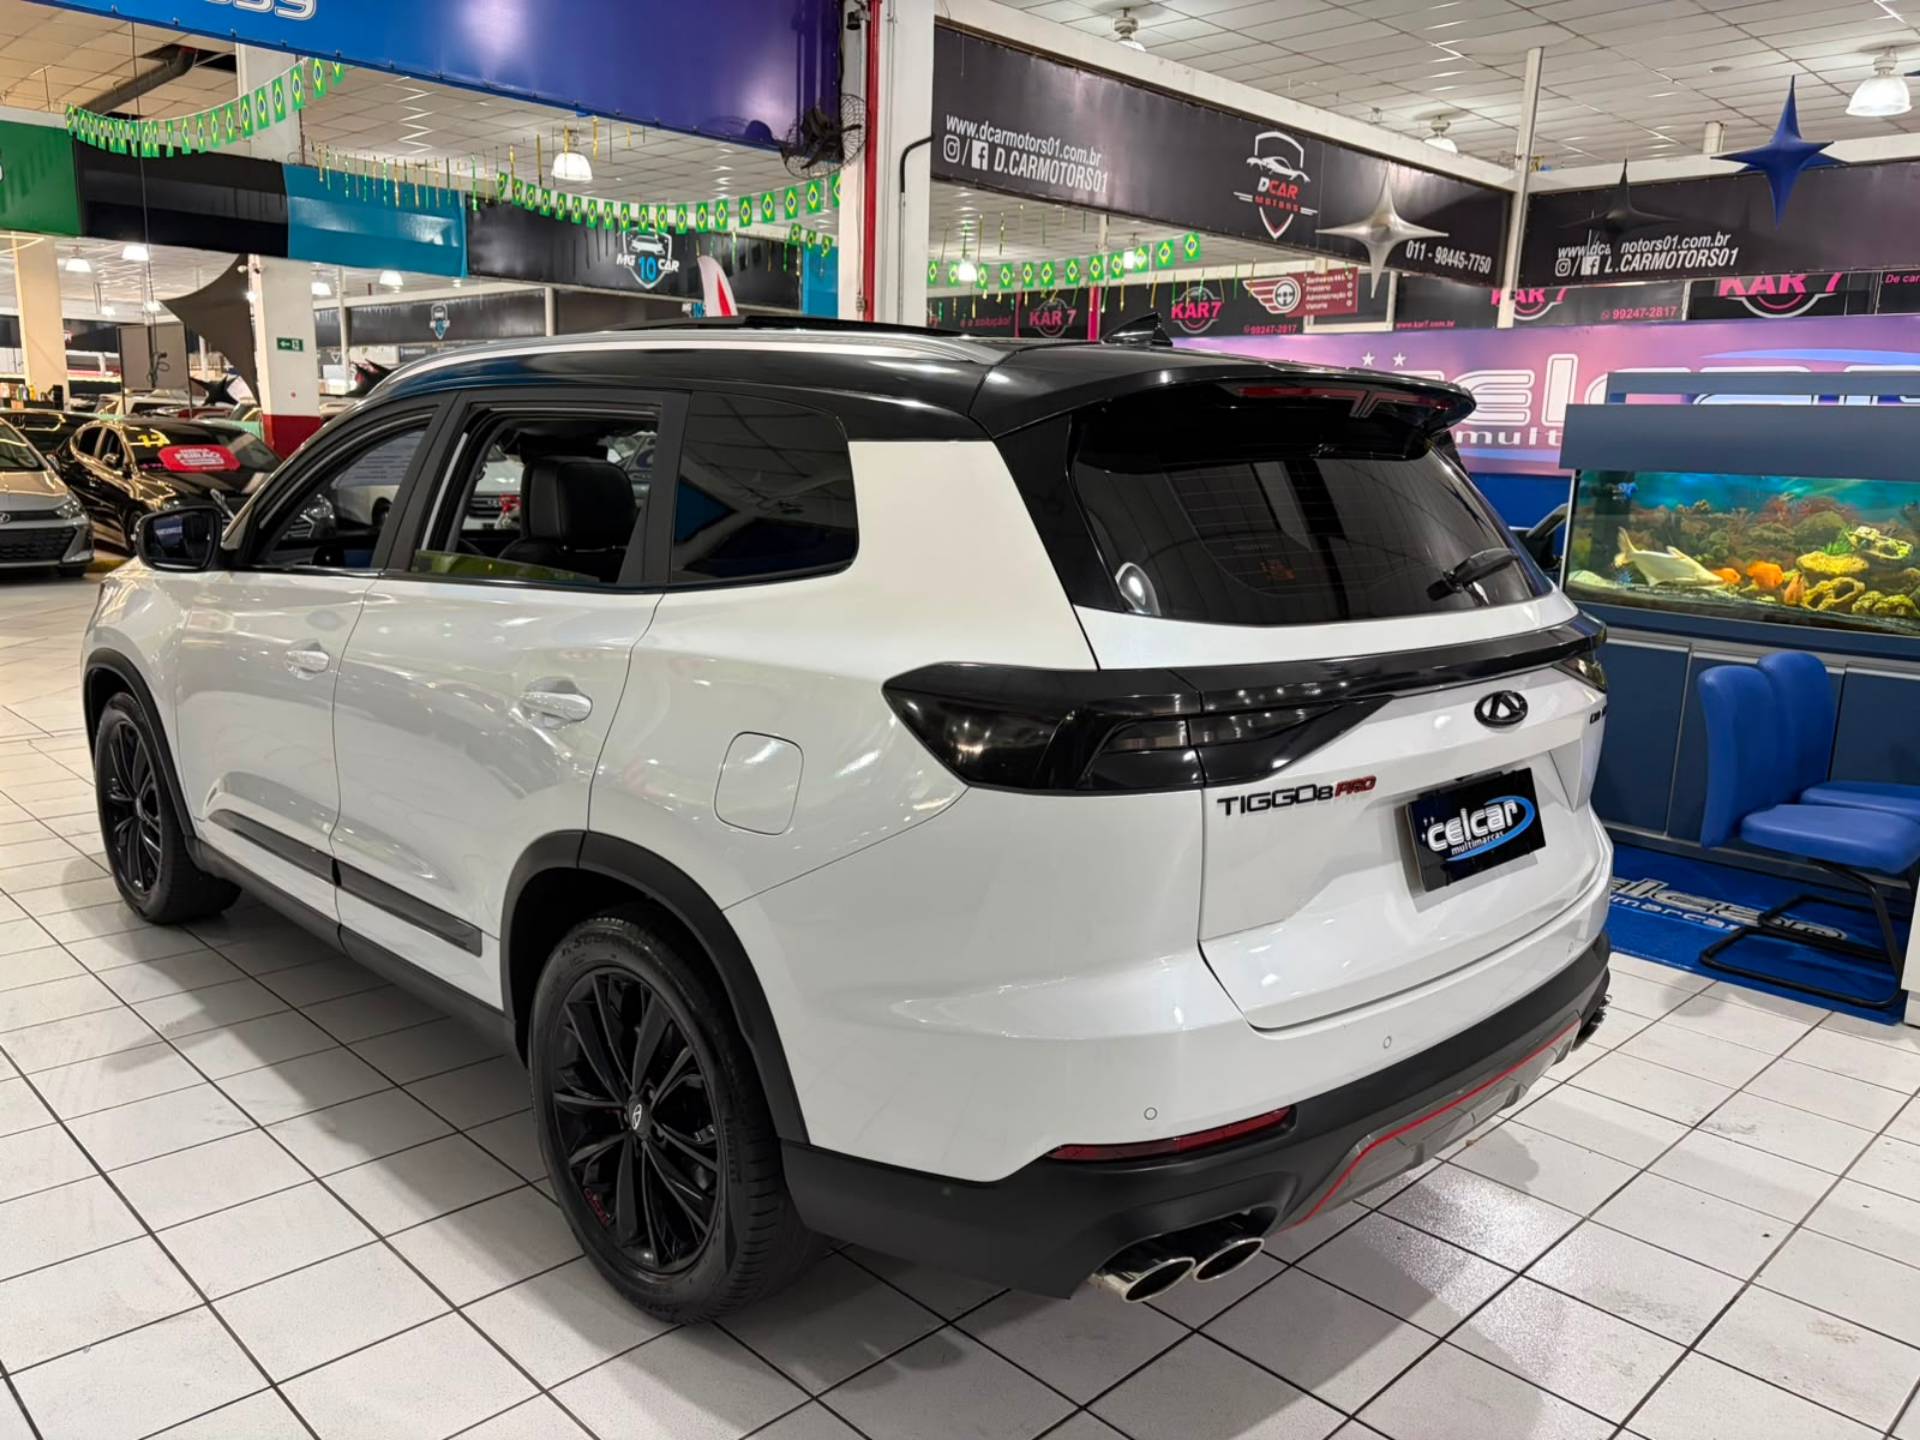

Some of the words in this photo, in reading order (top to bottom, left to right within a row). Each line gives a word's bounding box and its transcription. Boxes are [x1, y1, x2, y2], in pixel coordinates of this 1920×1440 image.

[946, 115, 1102, 167] www.dcarmotors01.com.br
[994, 148, 1108, 193] D.CARMOTORS01
[1257, 176, 1299, 199] DCAR
[616, 253, 636, 267] MG
[638, 255, 657, 282] 10
[657, 258, 680, 272] CAR
[1405, 240, 1427, 261] 011
[1434, 245, 1493, 274] 98445-7750
[1028, 311, 1063, 327] KAR
[1066, 308, 1078, 326] 7
[1612, 305, 1678, 320] 99247-2817
[1427, 799, 1518, 852] celcar
